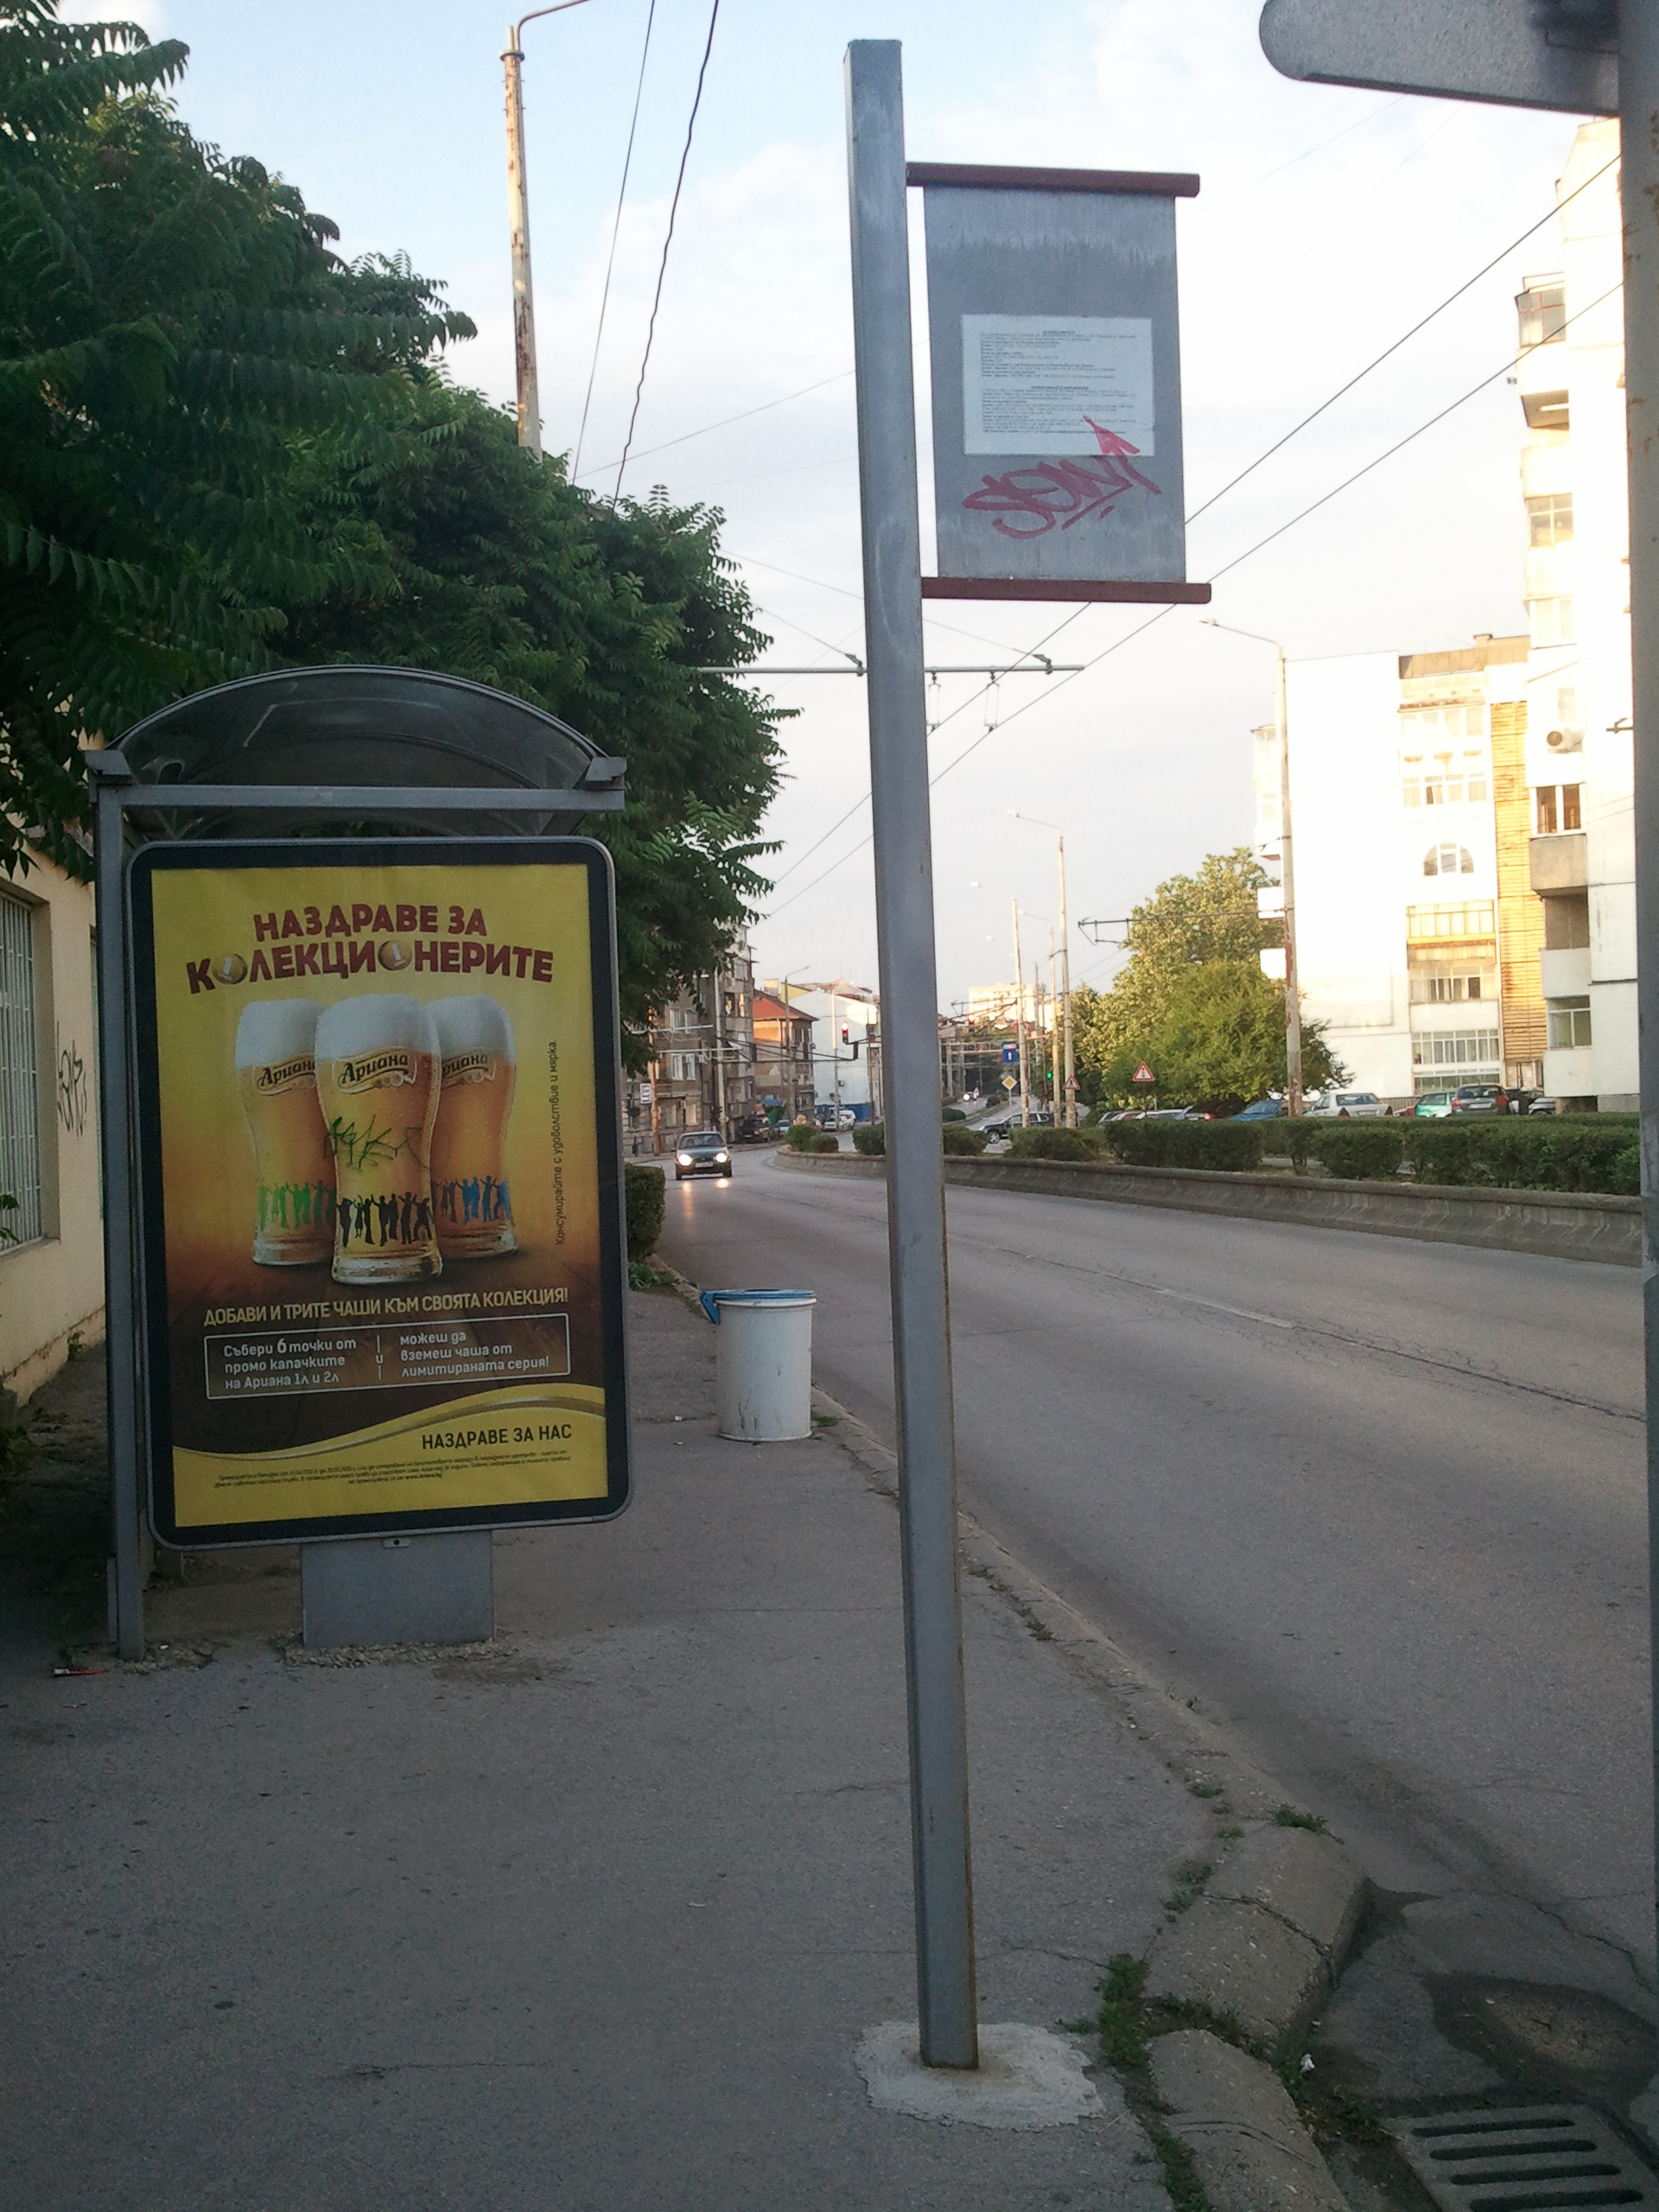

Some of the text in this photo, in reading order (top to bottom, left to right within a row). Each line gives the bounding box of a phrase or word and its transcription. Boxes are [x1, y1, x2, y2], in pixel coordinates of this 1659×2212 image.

[253, 904, 487, 942] НАЗДРАВЕ ЗА
[340, 1052, 409, 1085] Ариана
[549, 1084, 563, 1154] удоволствие
[554, 1166, 566, 1245] Консумирайте
[204, 1287, 569, 1327] ДОБАВИ И ТРИТЕ ЧАШИ КЪМ СВОЯТА КОЛЕКЦИЯ!
[224, 1338, 357, 1357] Събери 6 точки от
[400, 1332, 467, 1345] можеш да
[400, 1343, 512, 1362] вземеш чаша от
[225, 1355, 346, 1376] промо капачките
[402, 1356, 550, 1377] лимитираната серия!
[225, 1370, 340, 1389] на Ариана 1л и 2л
[422, 1424, 572, 1450] НАЗДРАВЕ ЗА НАС
